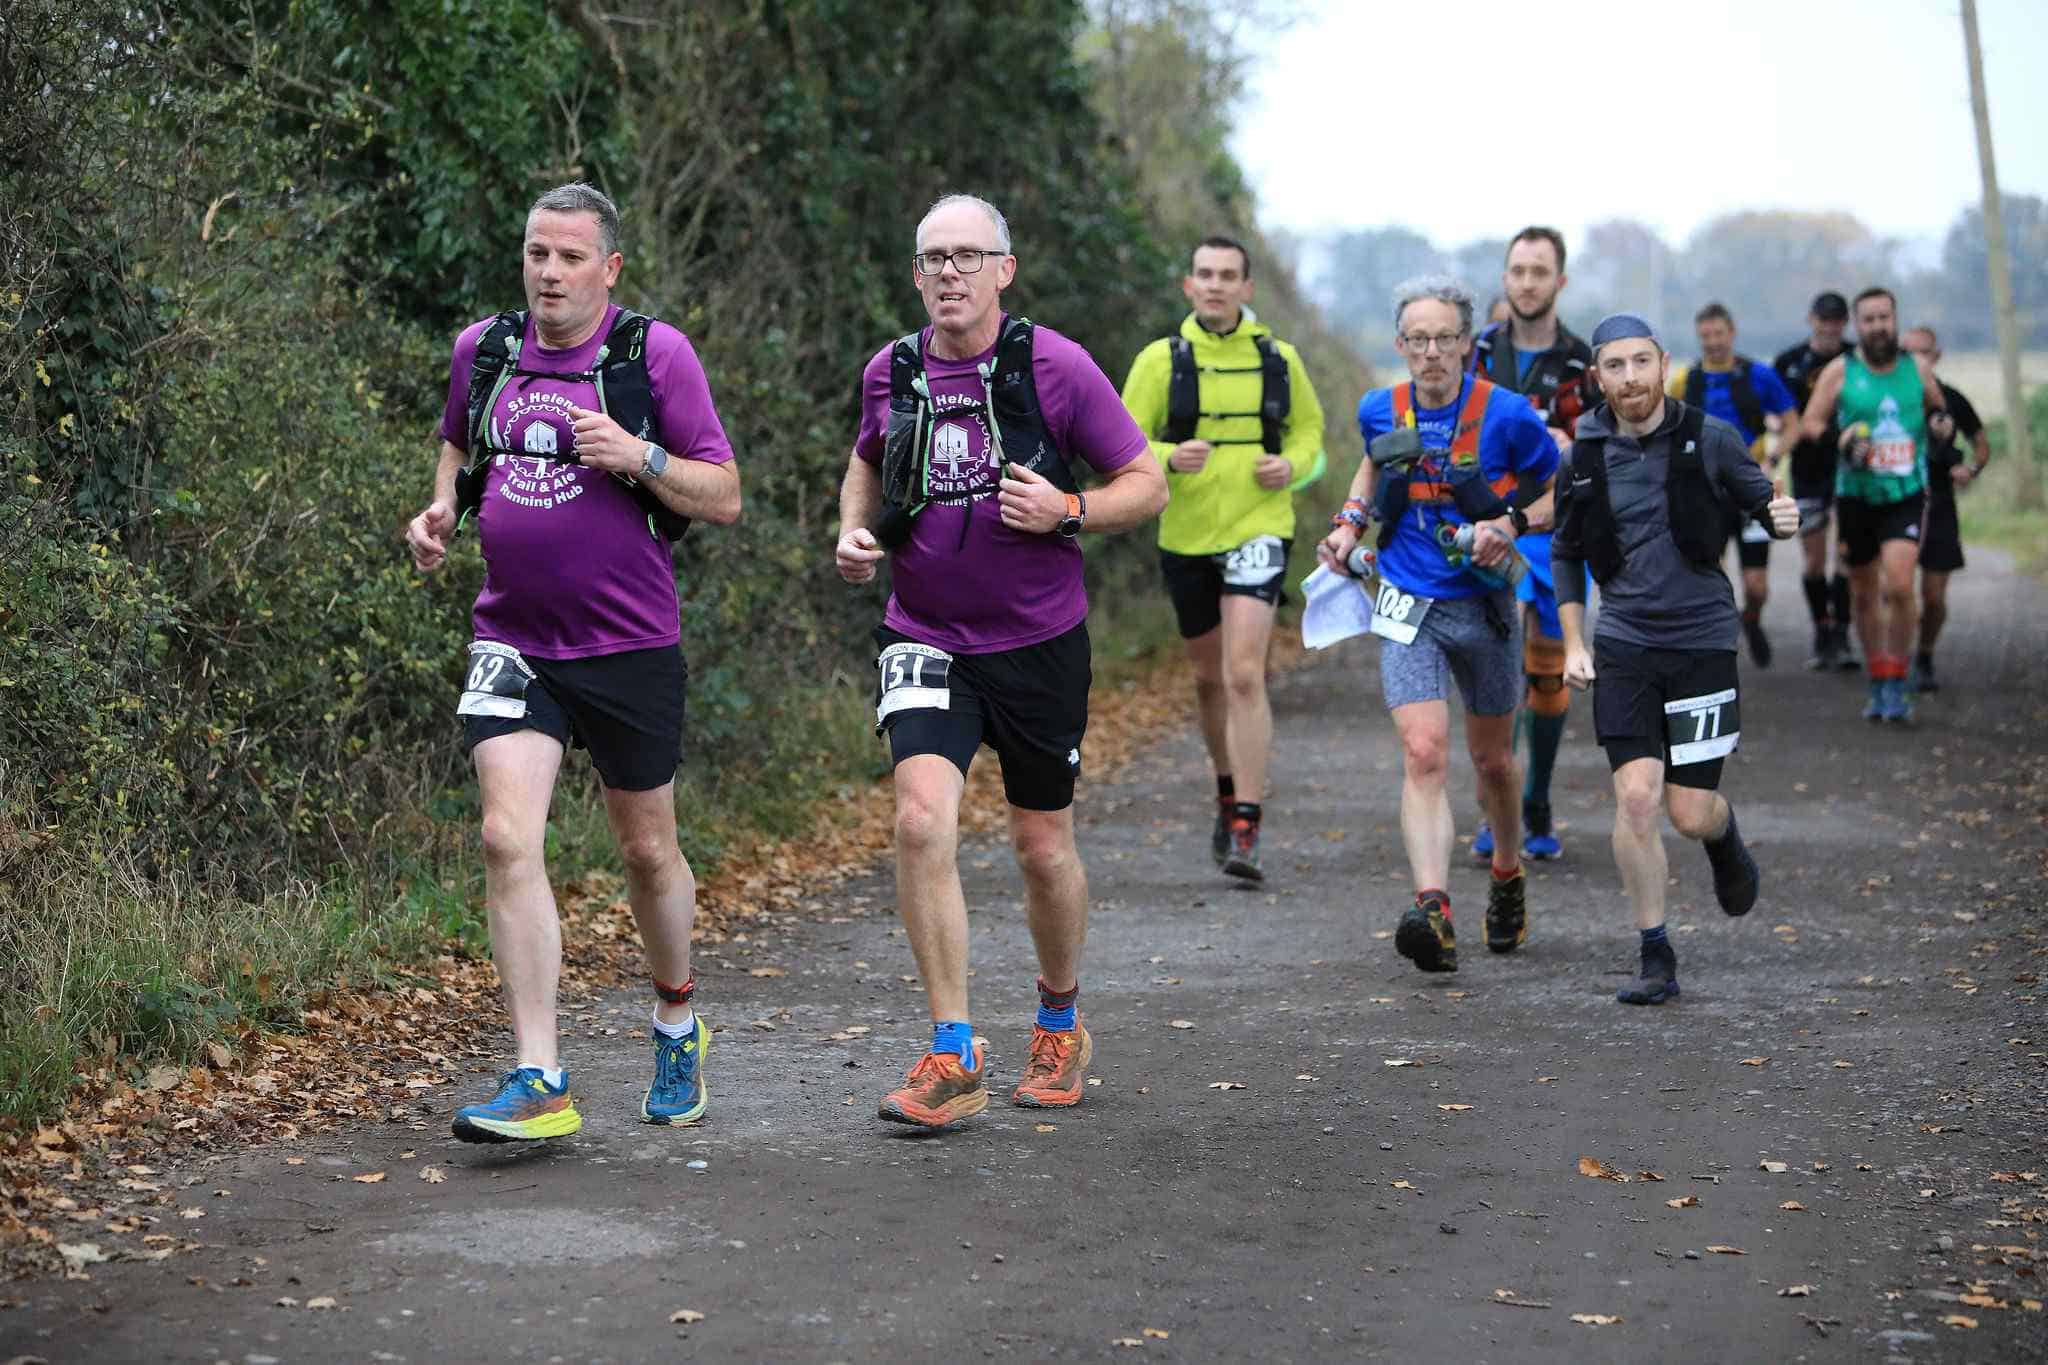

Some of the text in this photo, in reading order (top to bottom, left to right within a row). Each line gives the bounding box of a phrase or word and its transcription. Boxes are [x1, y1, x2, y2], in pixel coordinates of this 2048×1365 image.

[507, 396, 525, 412] St
[499, 484, 584, 509] Running Hub
[507, 470, 576, 493] Trail & Ale
[928, 472, 990, 493] rail & Ale
[1375, 584, 1415, 621] 108
[468, 654, 504, 692] 62
[881, 654, 924, 695] 151
[1690, 705, 1720, 741] 77
